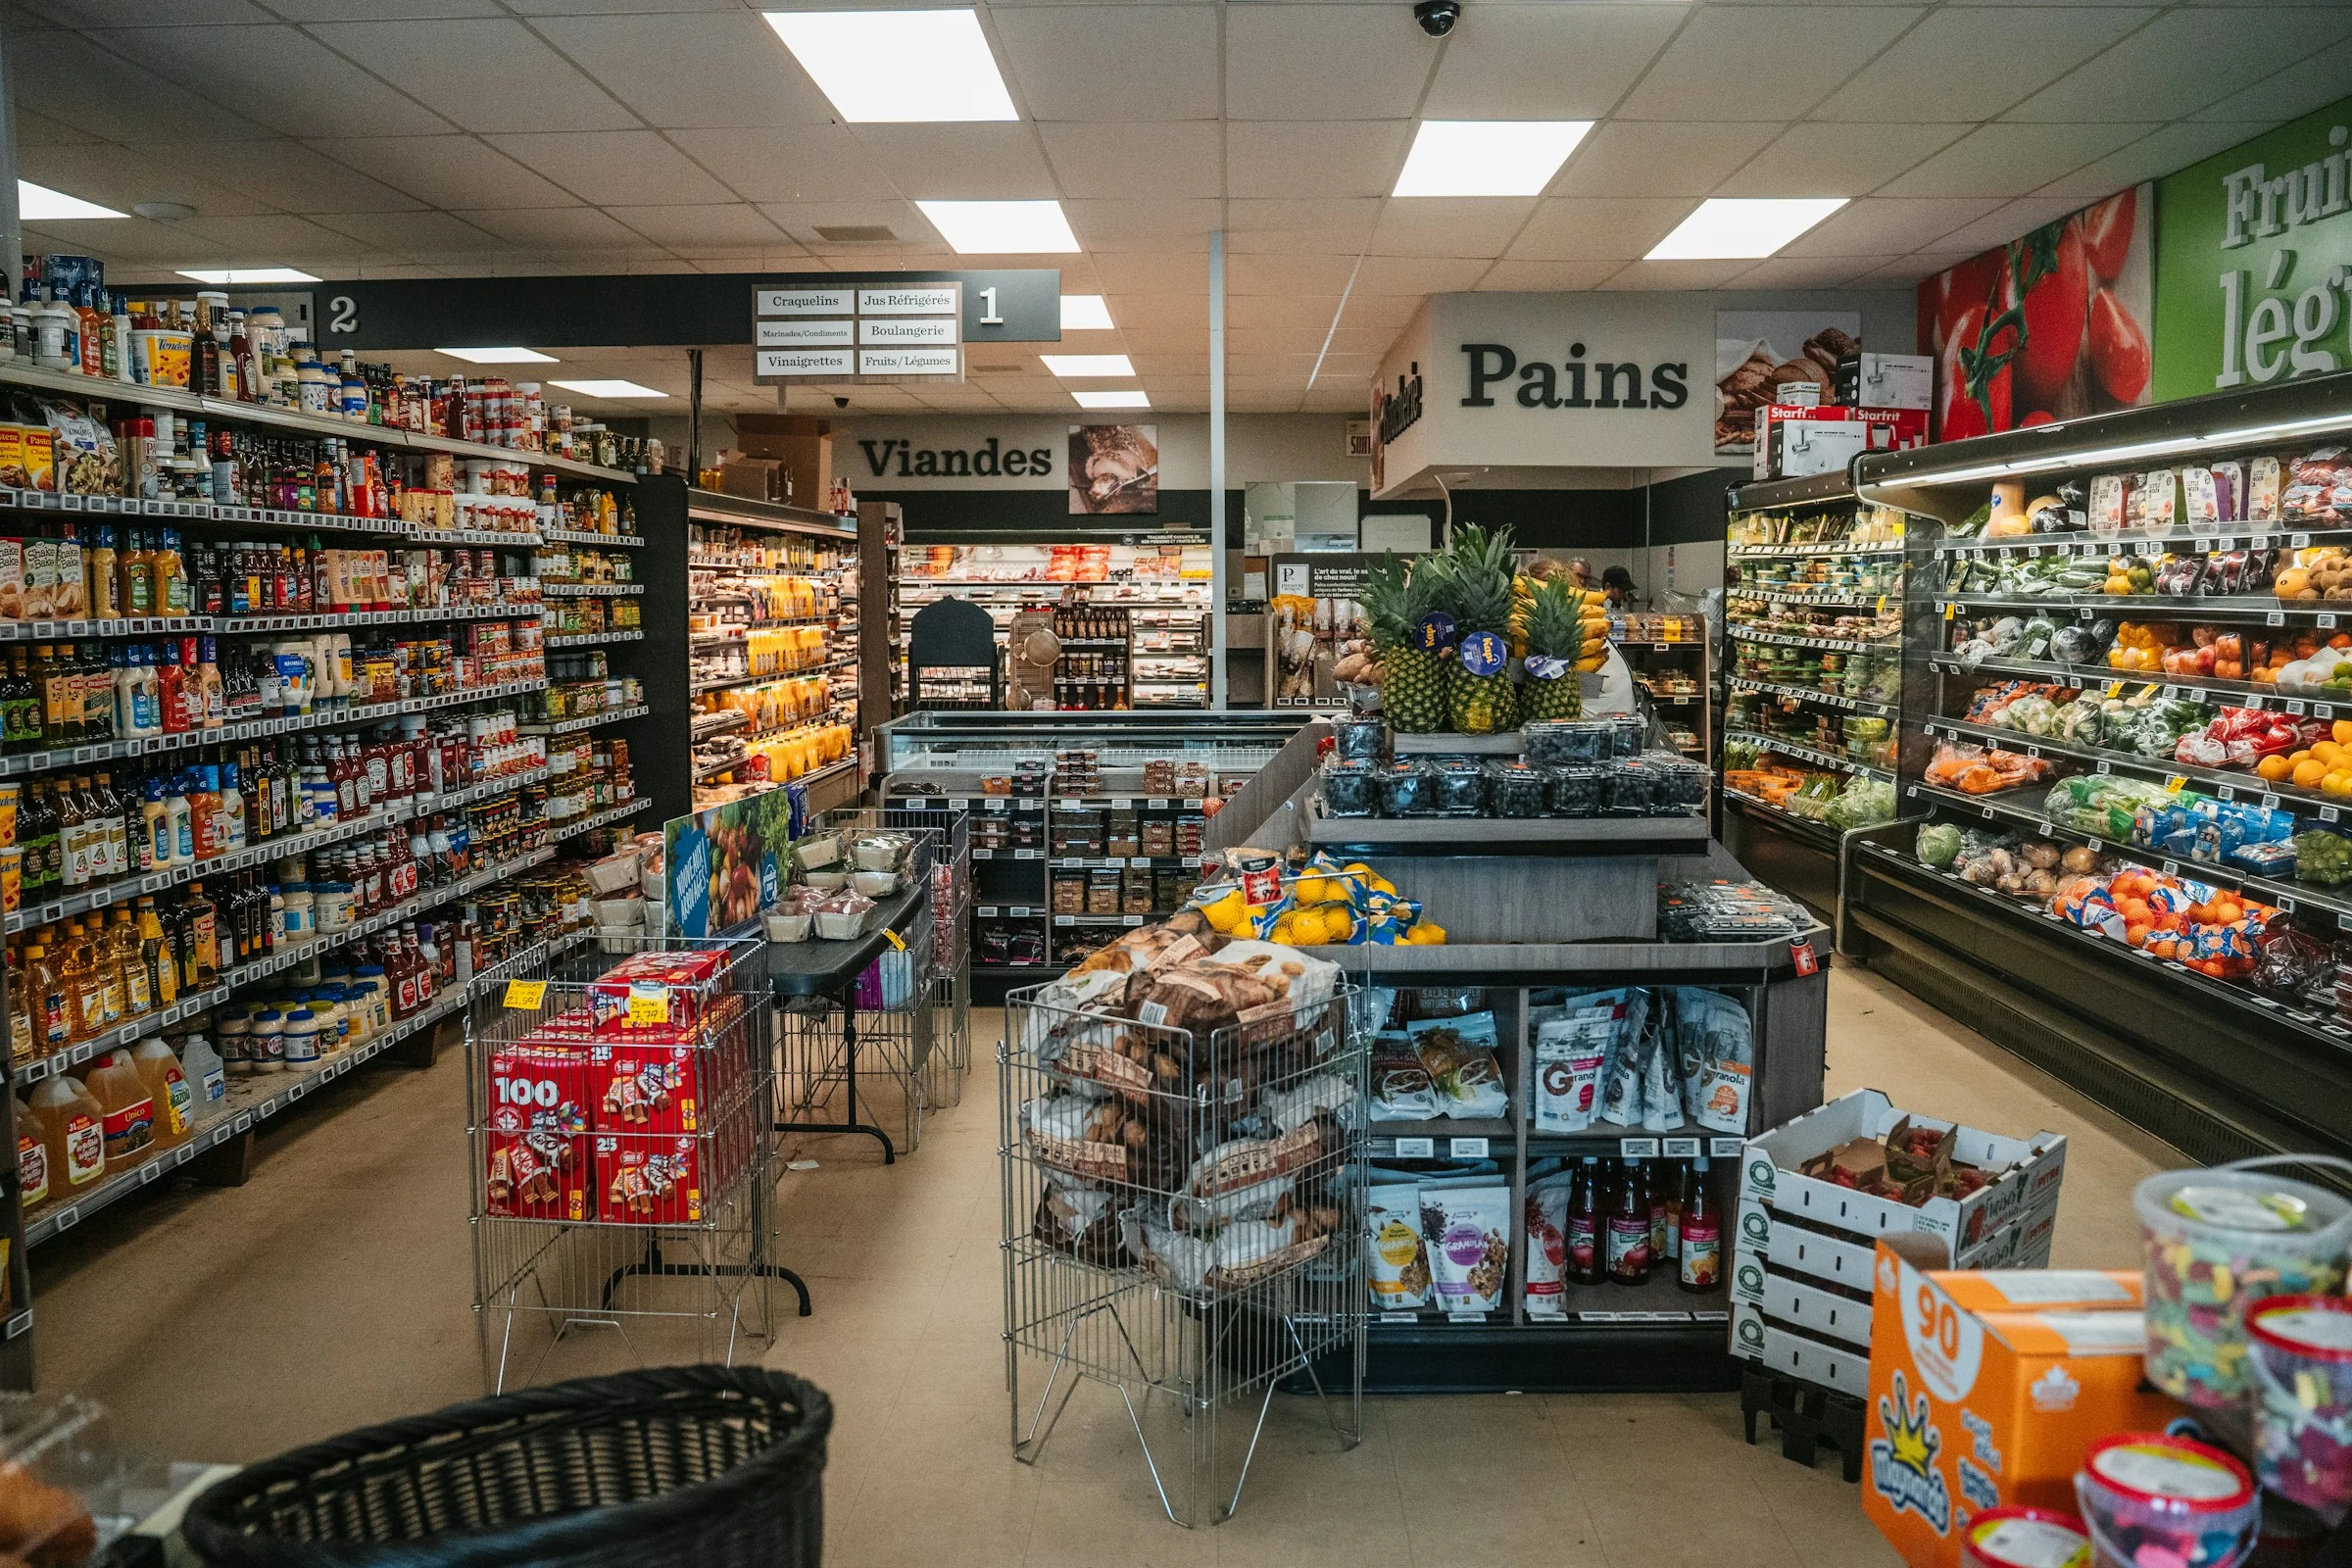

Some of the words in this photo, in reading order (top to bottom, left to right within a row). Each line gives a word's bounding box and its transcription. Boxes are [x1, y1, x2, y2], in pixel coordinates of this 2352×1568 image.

[2221, 125, 2352, 250] Frui
[772, 295, 839, 309] Craquelins
[864, 295, 886, 306] Jus
[888, 294, 951, 309] Réfrigérés
[980, 286, 1004, 323] 1
[330, 296, 359, 333] 2
[762, 329, 848, 338] Marinades/Condiments
[871, 325, 944, 339] Boulangerie
[768, 356, 843, 368] Vinaigrettes
[865, 357, 897, 367] Fruits
[906, 356, 951, 368] Légumes
[1461, 343, 1689, 409] Pains
[1857, 410, 1900, 421] Starfrit
[858, 438, 1053, 477] Viandes
[27, 546, 56, 562] Shake
[34, 557, 55, 570] Bake
[676, 840, 705, 901] NOUVEAUX
[495, 1076, 560, 1107] 100
[124, 1107, 146, 1123] Unico
[596, 1137, 618, 1152] 25
[1446, 1240, 1485, 1251] GRANOLA
[1918, 1285, 1959, 1363] 90
